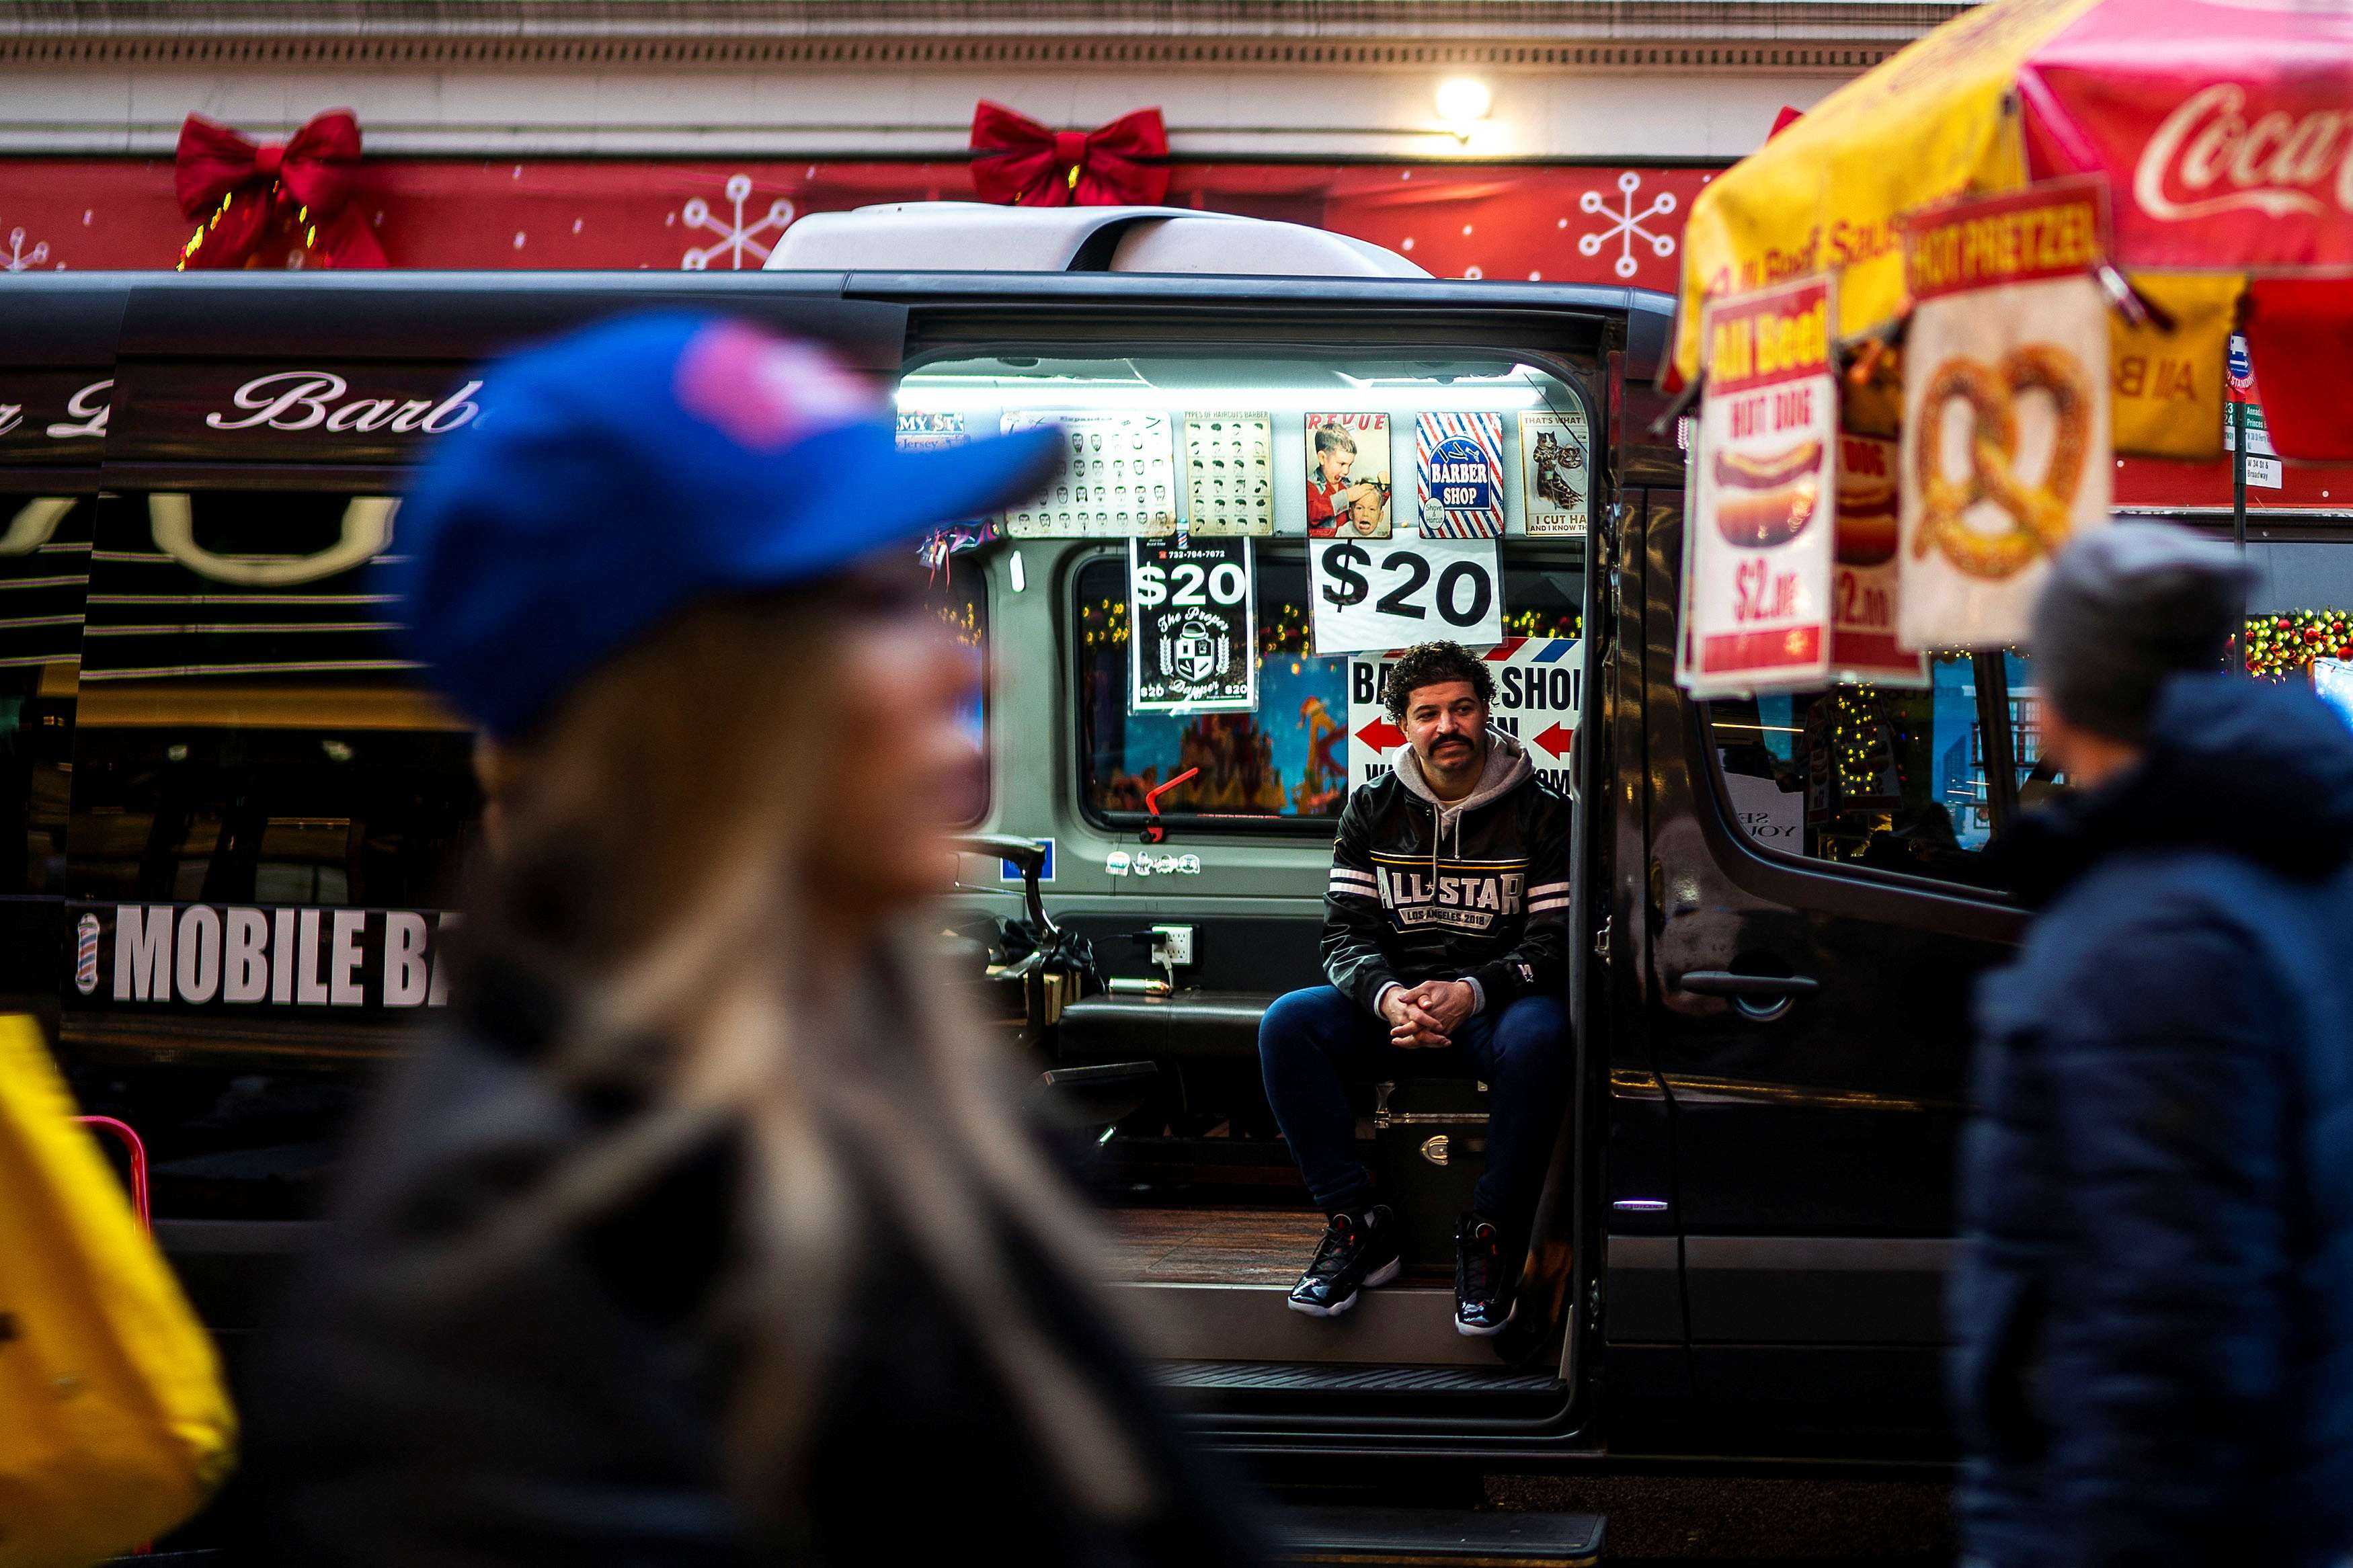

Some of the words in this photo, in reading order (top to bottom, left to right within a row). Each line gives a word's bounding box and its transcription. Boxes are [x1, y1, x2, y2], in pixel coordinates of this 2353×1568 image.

[1431, 462, 1488, 484] BARBER
[1443, 487, 1478, 505] SHOP
[1536, 515, 1540, 525] I
[1544, 515, 1566, 525] CUT
[1136, 554, 1246, 611] $20
[1321, 538, 1492, 628] $20
[1157, 612, 1182, 633] The
[1224, 684, 1248, 695] $20
[1377, 866, 1434, 909] ALL
[1439, 873, 1525, 915] STAR
[1407, 910, 1424, 921] LOS
[1425, 910, 1462, 923] ANGELES
[1464, 914, 1485, 926] 2018
[114, 904, 366, 1005] MOBILE
